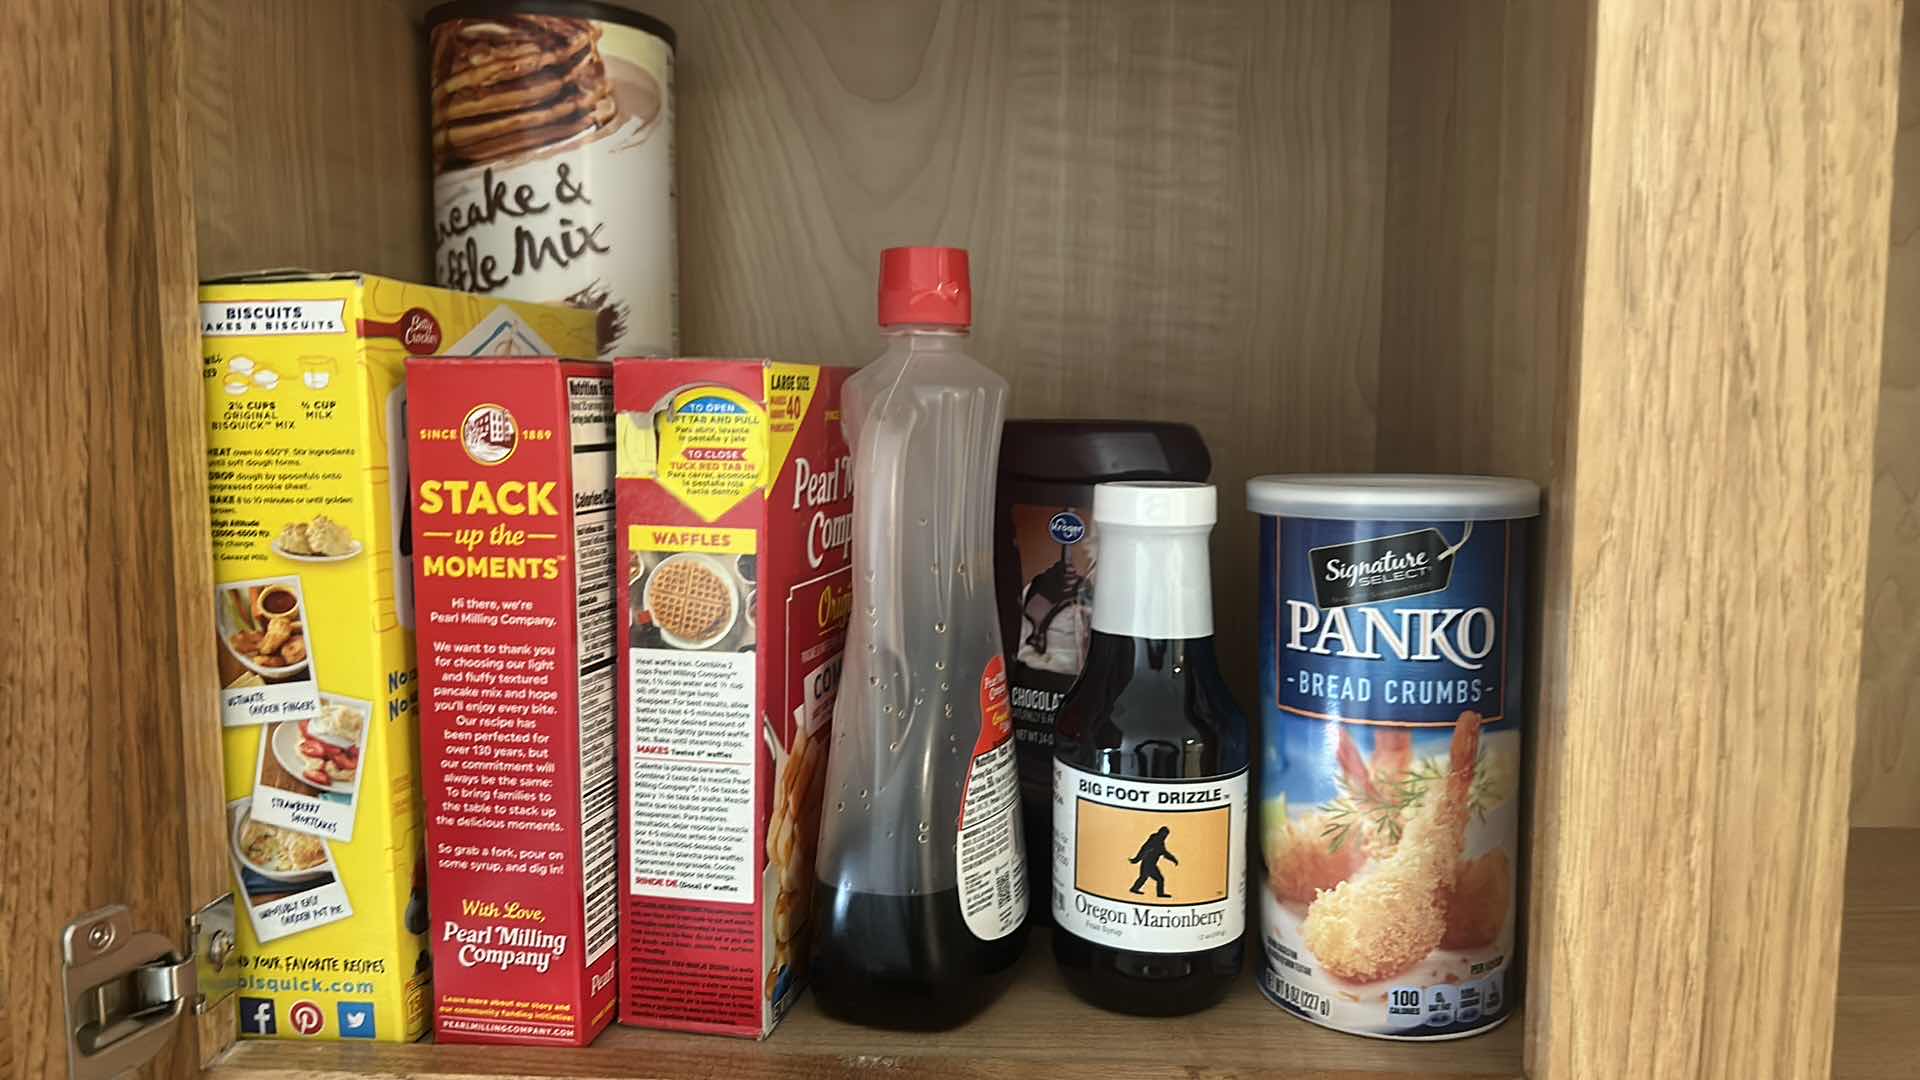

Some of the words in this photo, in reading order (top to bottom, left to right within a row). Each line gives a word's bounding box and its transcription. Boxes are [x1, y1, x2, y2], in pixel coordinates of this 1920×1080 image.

[556, 163, 591, 205] &
[512, 218, 610, 275] Mix
[226, 307, 302, 318] BISCUITS
[266, 320, 335, 331] BISCUITS
[771, 374, 795, 390] LARGE
[797, 376, 810, 390] SIZE
[306, 411, 332, 419] MILK
[786, 396, 800, 419] 40
[223, 412, 278, 420] ORIGINAL
[690, 416, 706, 424] TAB
[735, 416, 759, 424] PULL
[276, 421, 296, 429] MIX
[420, 429, 457, 440] SINCE
[523, 430, 552, 440] 1889
[704, 451, 736, 459] CLOSE
[792, 458, 839, 509] Pearl
[419, 479, 559, 516] STACK
[1051, 518, 1083, 538] Kroger
[455, 529, 484, 551] up
[490, 523, 525, 546] the
[652, 531, 731, 547] WAFFLES
[1325, 550, 1430, 588] Signature
[1358, 567, 1428, 587] SELECT
[451, 598, 464, 608] Hi
[467, 599, 500, 610] there,
[502, 601, 533, 610] we're
[430, 612, 459, 623] Pearl
[461, 613, 498, 626] Milling
[501, 615, 557, 627] Company.
[1286, 600, 1495, 670] PANKO
[433, 642, 451, 651] We
[453, 644, 480, 653] want
[484, 644, 496, 653] to
[498, 644, 531, 654] thank
[534, 646, 555, 656] you
[435, 657, 451, 666] for
[453, 657, 504, 670] choosing
[506, 660, 525, 669] our
[528, 659, 555, 671] light
[442, 672, 463, 682] and
[465, 673, 496, 685] fluffy
[498, 674, 548, 685] textured
[433, 689, 479, 699] pancake
[481, 689, 503, 698] mix
[505, 689, 527, 699] and
[529, 690, 558, 701] hope
[1299, 670, 1371, 701] BREAD
[1384, 679, 1482, 705] CRUMBS
[434, 701, 464, 712] you'll
[465, 702, 495, 714] enjoy
[498, 705, 529, 715] every
[531, 704, 557, 715] bite.
[456, 715, 477, 726] Our
[479, 717, 514, 729] recipe
[516, 718, 536, 728] has
[444, 730, 473, 741] been
[474, 731, 530, 744] perfected
[532, 732, 550, 743] for
[446, 746, 470, 754] over
[472, 745, 491, 755] 130
[494, 748, 525, 759] years,
[528, 748, 549, 758] but
[441, 760, 459, 769] our
[461, 760, 533, 772] commitment
[536, 762, 555, 773] will
[444, 775, 479, 785] always
[481, 775, 496, 785] be
[498, 776, 517, 786] the
[519, 778, 553, 787] same:
[446, 787, 459, 797] To
[461, 788, 491, 801] bring
[493, 789, 536, 801] families
[538, 792, 552, 801] to
[1079, 779, 1102, 796] BIG
[1106, 785, 1149, 804] FOOT
[1158, 789, 1222, 804] DRIZZLE
[442, 801, 460, 811] the
[464, 802, 492, 814] table
[494, 804, 507, 814] to
[509, 805, 539, 816] stack
[541, 808, 556, 818] up
[436, 815, 454, 825] the
[457, 816, 505, 829] delicious
[507, 820, 564, 832] moments.
[438, 843, 452, 854] So
[455, 845, 479, 857] grab
[482, 847, 489, 856] a
[491, 847, 518, 858] fork,
[520, 850, 546, 861] pour
[549, 851, 564, 860] on
[438, 859, 467, 869] some
[470, 860, 503, 872] syrup,
[505, 862, 527, 872] and
[529, 863, 548, 875] dig
[550, 864, 564, 875] in!
[462, 899, 500, 918] With
[503, 901, 546, 923] Love,
[1074, 893, 1127, 925] Oregon
[1133, 908, 1225, 928] Marionberry
[443, 921, 492, 943] Pearl
[496, 926, 567, 956] Milling
[254, 955, 280, 969] YOUR
[285, 956, 339, 972] FAVORITE
[343, 959, 385, 974] RECIPES
[459, 944, 551, 973] Company
[443, 995, 464, 1003] Learn
[467, 997, 488, 1005] more
[490, 997, 514, 1007] about
[516, 999, 530, 1008] our
[532, 1001, 553, 1012] story
[555, 1002, 571, 1011] and
[1392, 990, 1419, 1006] 100
[454, 1007, 500, 1017] community
[502, 1008, 534, 1019] funding
[1389, 1007, 1420, 1015] CALORIES
[443, 1020, 574, 1037] PEARLMILLINGCOMPANY.COM
